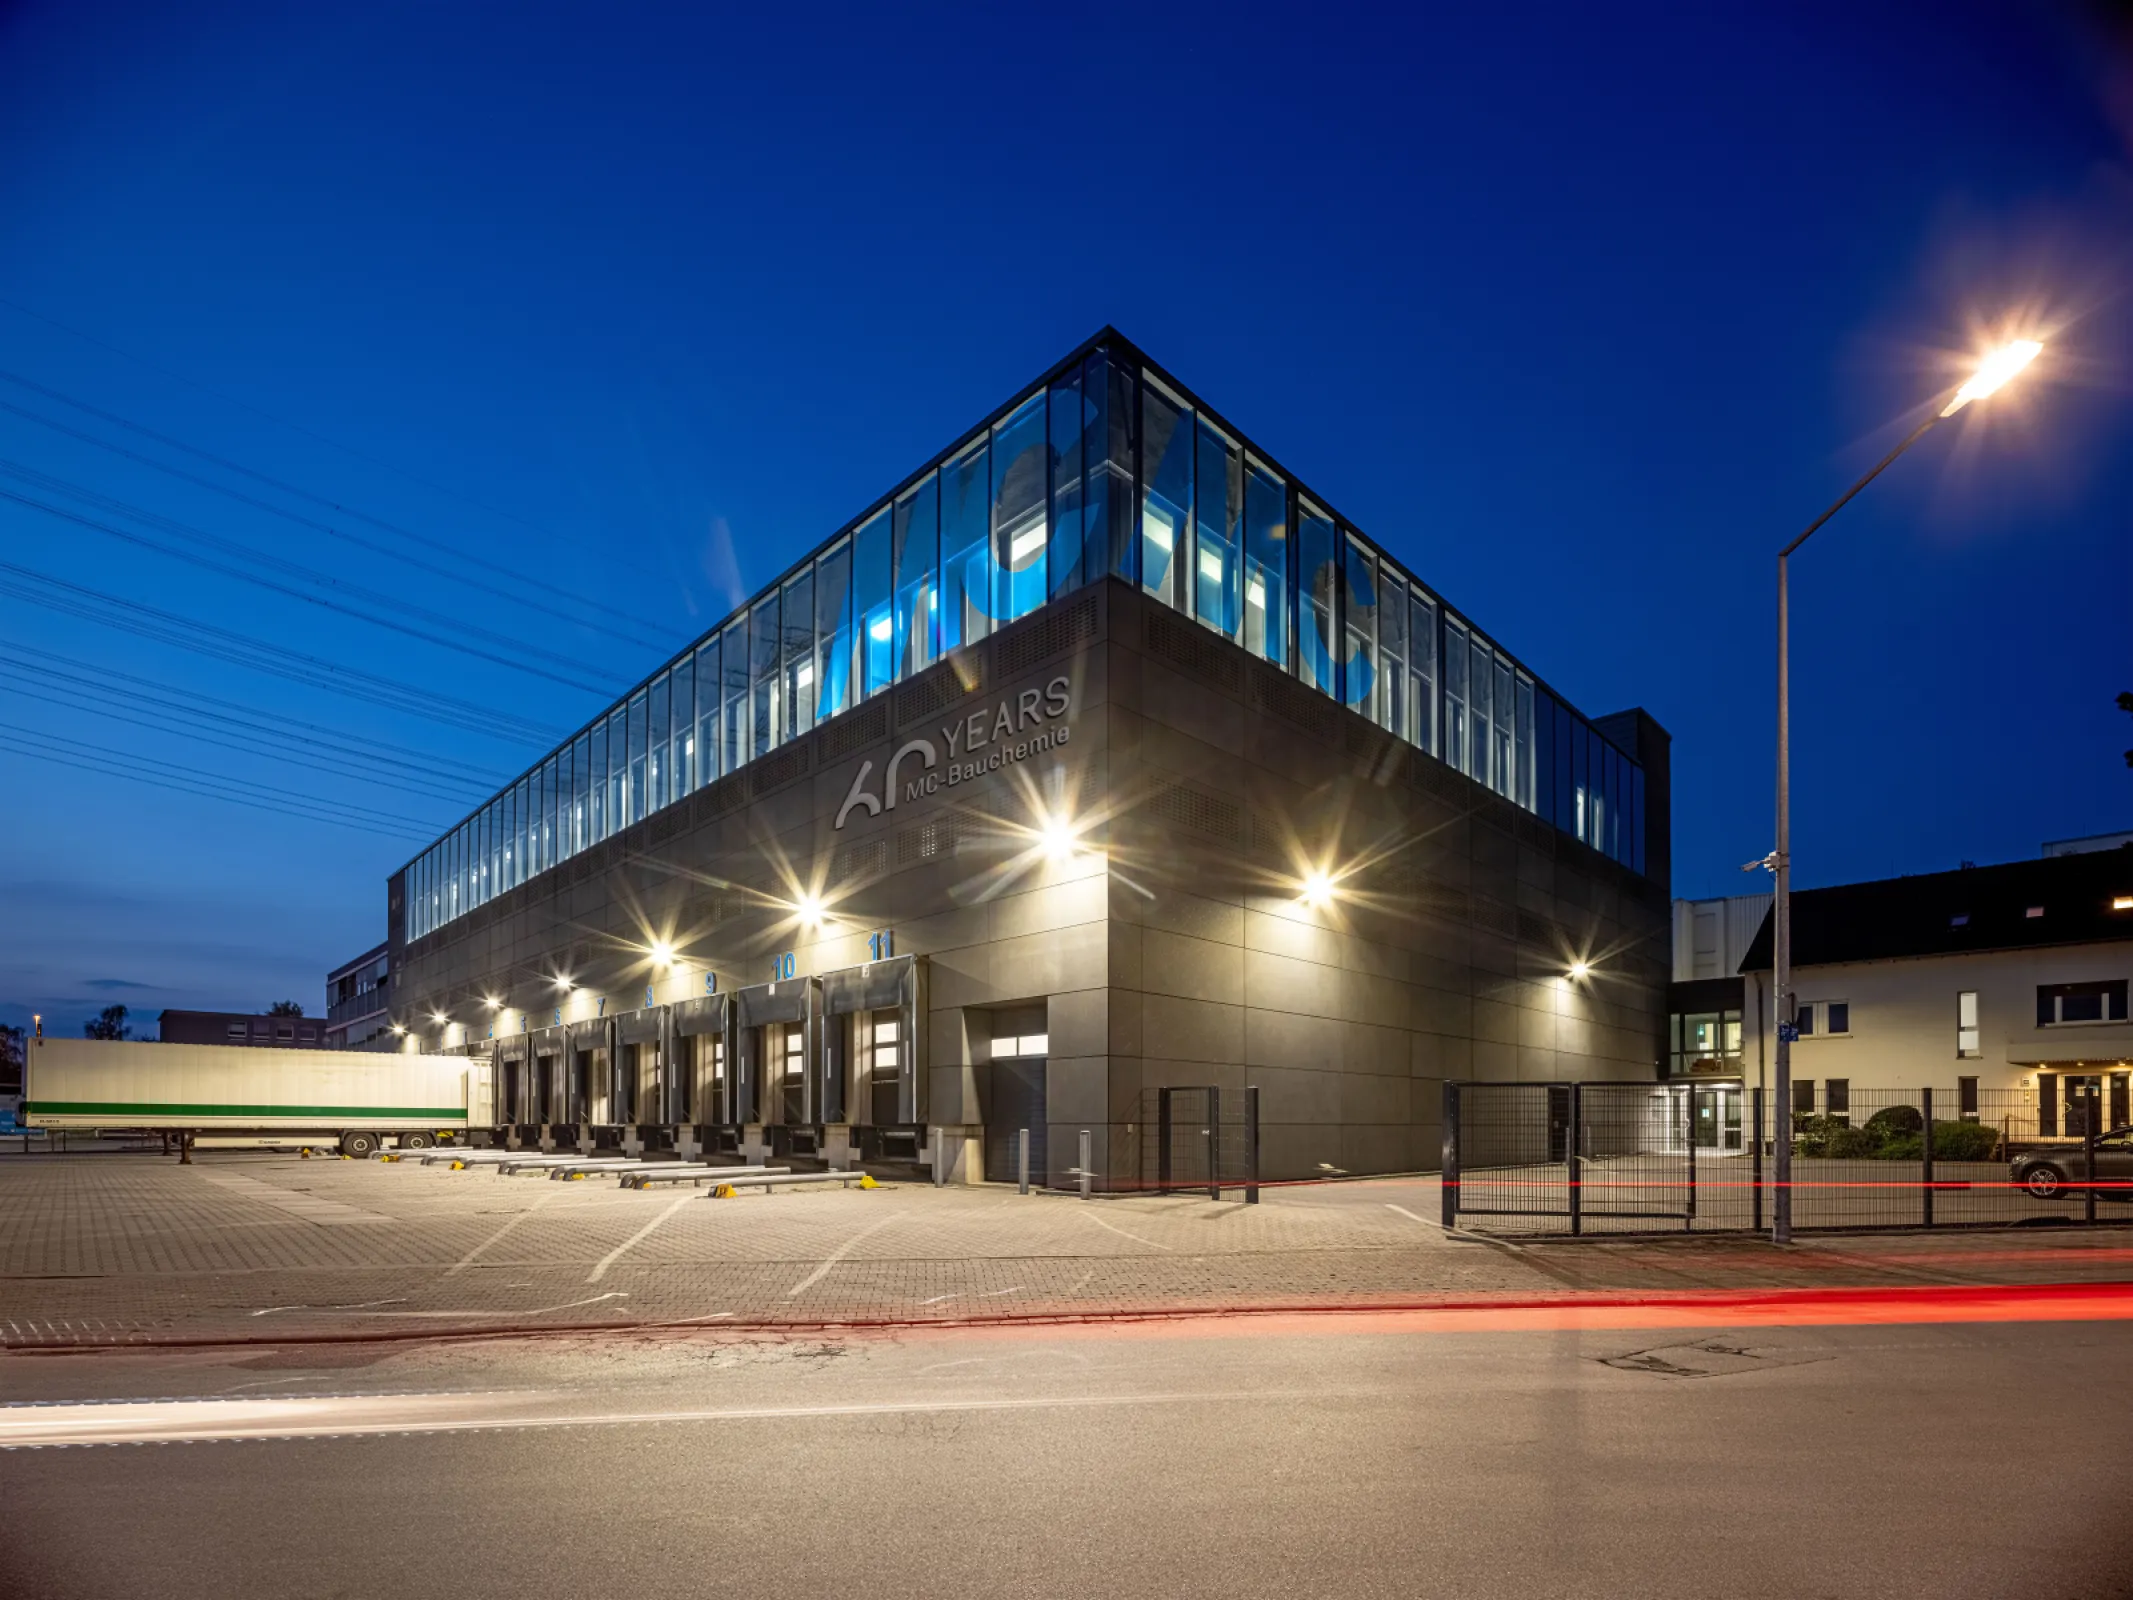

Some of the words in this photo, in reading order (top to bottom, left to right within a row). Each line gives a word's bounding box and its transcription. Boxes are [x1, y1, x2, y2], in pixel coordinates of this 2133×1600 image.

[942, 676, 1070, 759] YEARS
[906, 725, 1070, 802] MC-Bauchemie
[868, 930, 893, 960] 11
[772, 953, 796, 980] 10
[645, 986, 654, 1007] 8
[705, 972, 716, 994] 9
[597, 997, 605, 1016] 7
